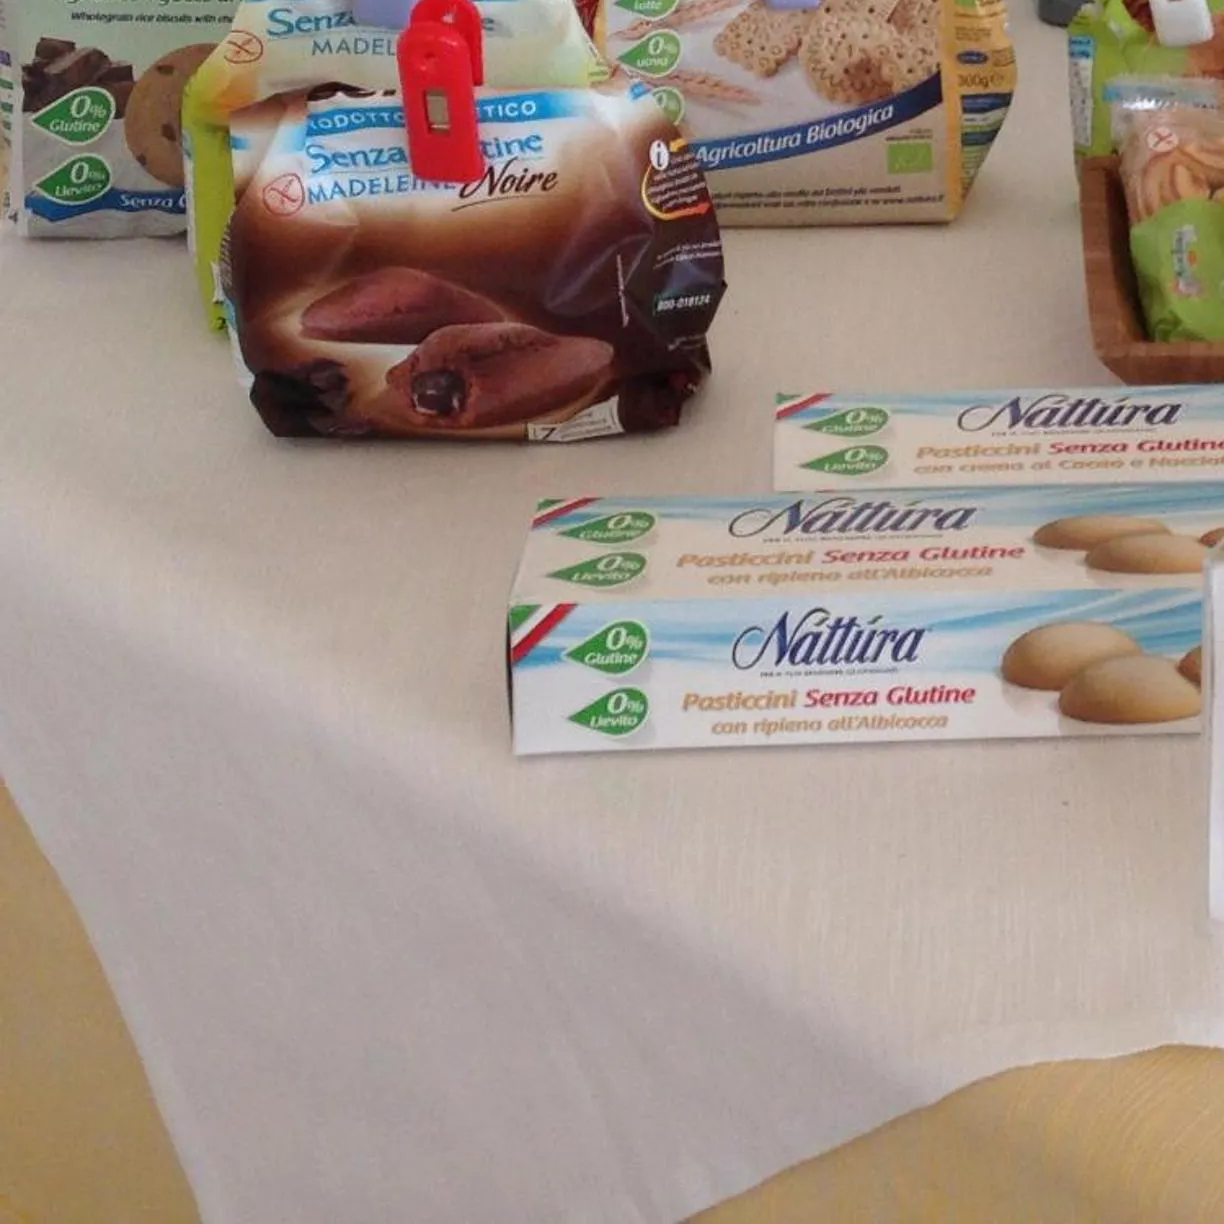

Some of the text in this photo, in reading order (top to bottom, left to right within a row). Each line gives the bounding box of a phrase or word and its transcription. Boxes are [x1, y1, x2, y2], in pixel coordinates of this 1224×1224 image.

[311, 37, 397, 57] MADEL
[70, 94, 108, 119] 0%
[50, 118, 101, 133] Glutine
[695, 104, 894, 165] Agricoltura Biologica
[305, 143, 408, 173] Senza
[459, 157, 558, 200] Noire
[119, 193, 174, 208] Senza
[915, 441, 1041, 460] Pasticcini
[1048, 440, 1130, 455] Senza
[912, 463, 953, 475] con
[958, 461, 1025, 474] crema
[1030, 458, 1052, 471] al
[1130, 458, 1144, 468] e
[676, 542, 1025, 569] Pasticcini Senza Glutine
[706, 571, 751, 585] con
[758, 569, 842, 587] ripieno
[606, 626, 644, 651] 0%
[583, 652, 639, 666] Glutine
[607, 692, 644, 715] 0%
[681, 684, 977, 712] Pasticcini Senza Glutine
[589, 715, 639, 729] Lievito
[711, 720, 748, 735] con
[752, 717, 823, 736] ripieno
